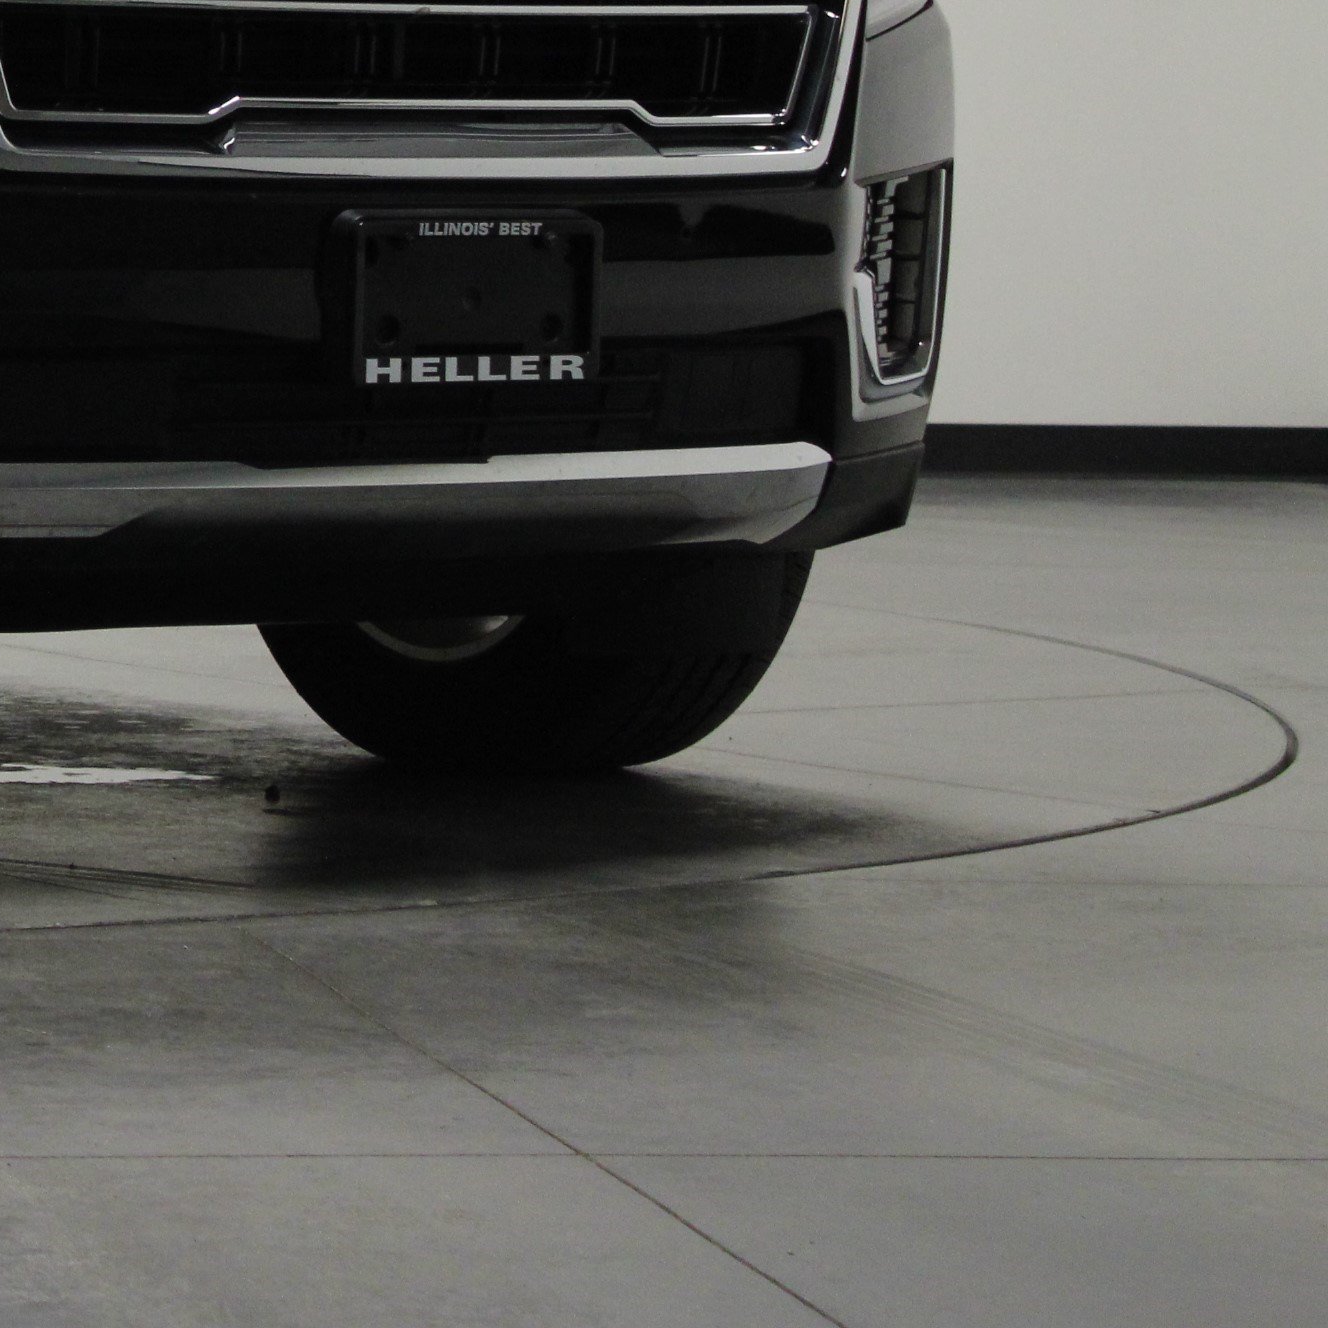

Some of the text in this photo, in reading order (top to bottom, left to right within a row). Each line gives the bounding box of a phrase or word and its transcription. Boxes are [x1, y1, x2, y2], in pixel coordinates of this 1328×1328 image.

[419, 222, 543, 237] ILLINOIS' BEST
[365, 355, 585, 384] HELLER
